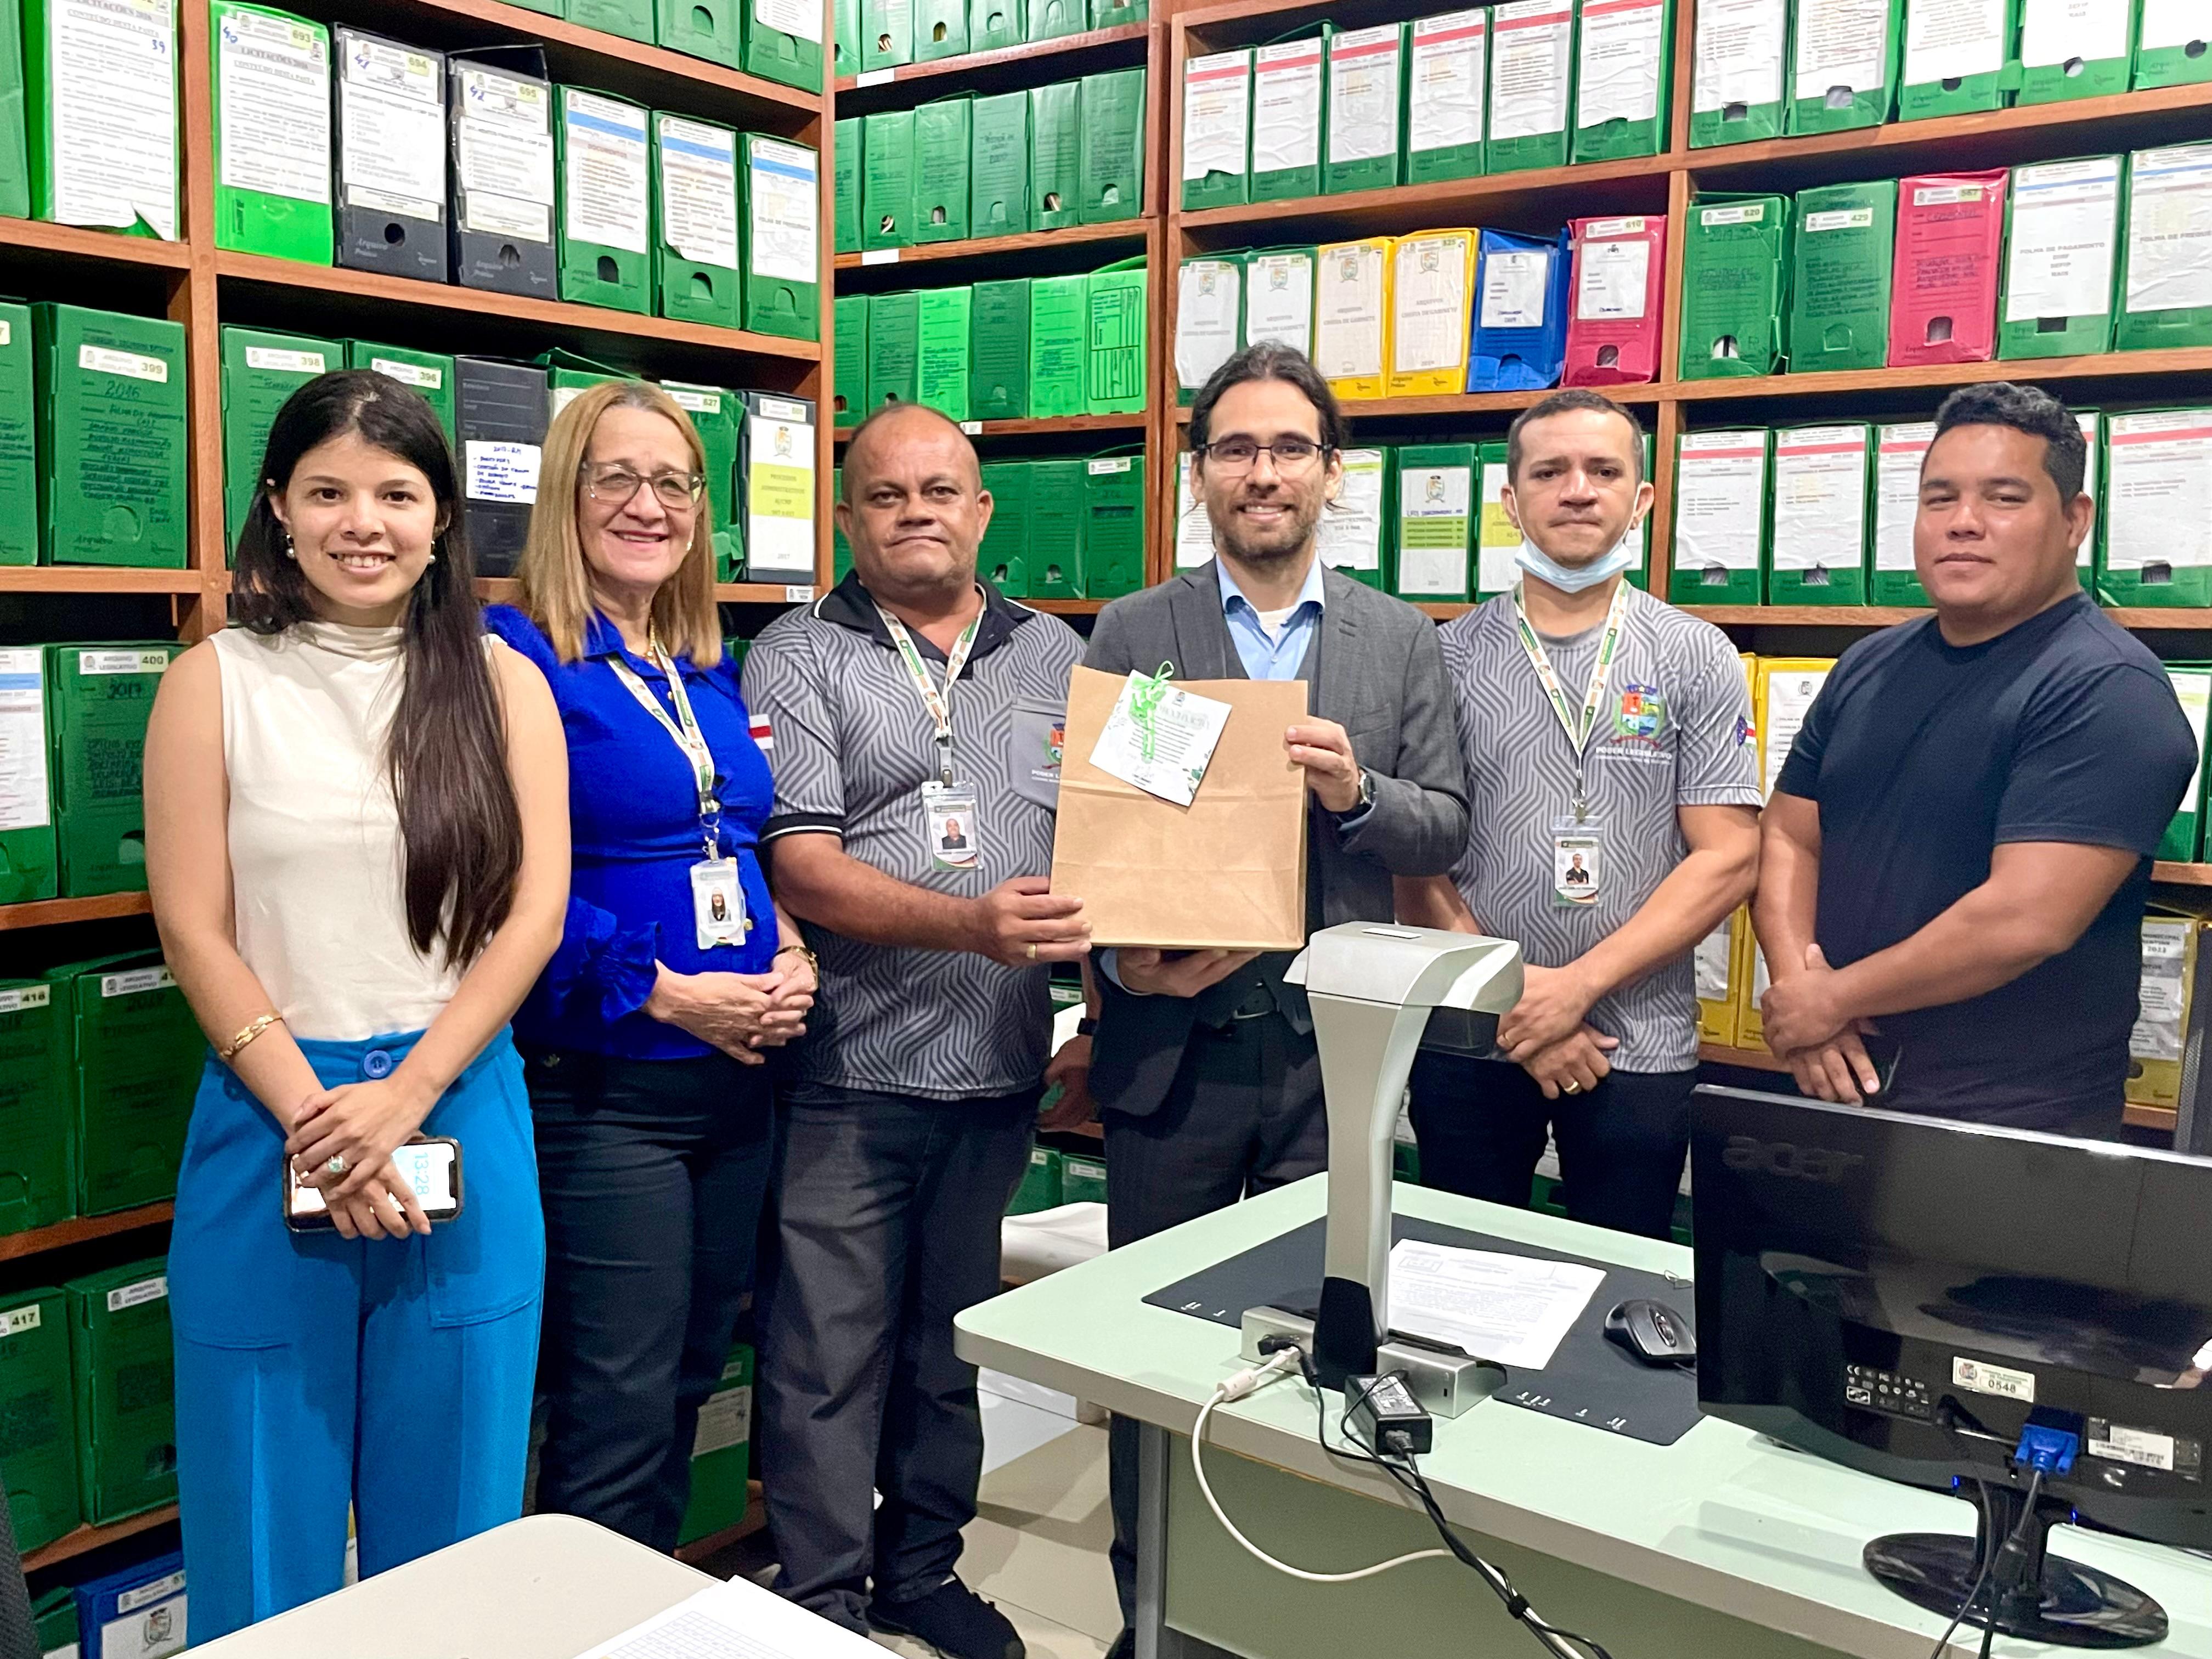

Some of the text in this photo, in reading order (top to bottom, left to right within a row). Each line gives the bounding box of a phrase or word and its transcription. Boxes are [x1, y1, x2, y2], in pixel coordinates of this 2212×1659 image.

[292, 30, 311, 43] 693
[152, 39, 165, 54] 39
[142, 362, 163, 374] 399
[301, 357, 320, 367] 398
[142, 656, 164, 665] 400
[1595, 746, 1624, 755] PODER
[414, 1152, 430, 1195] 13:28
[12, 1312, 36, 1326] 417
[1988, 1379, 2016, 1393] 0548
